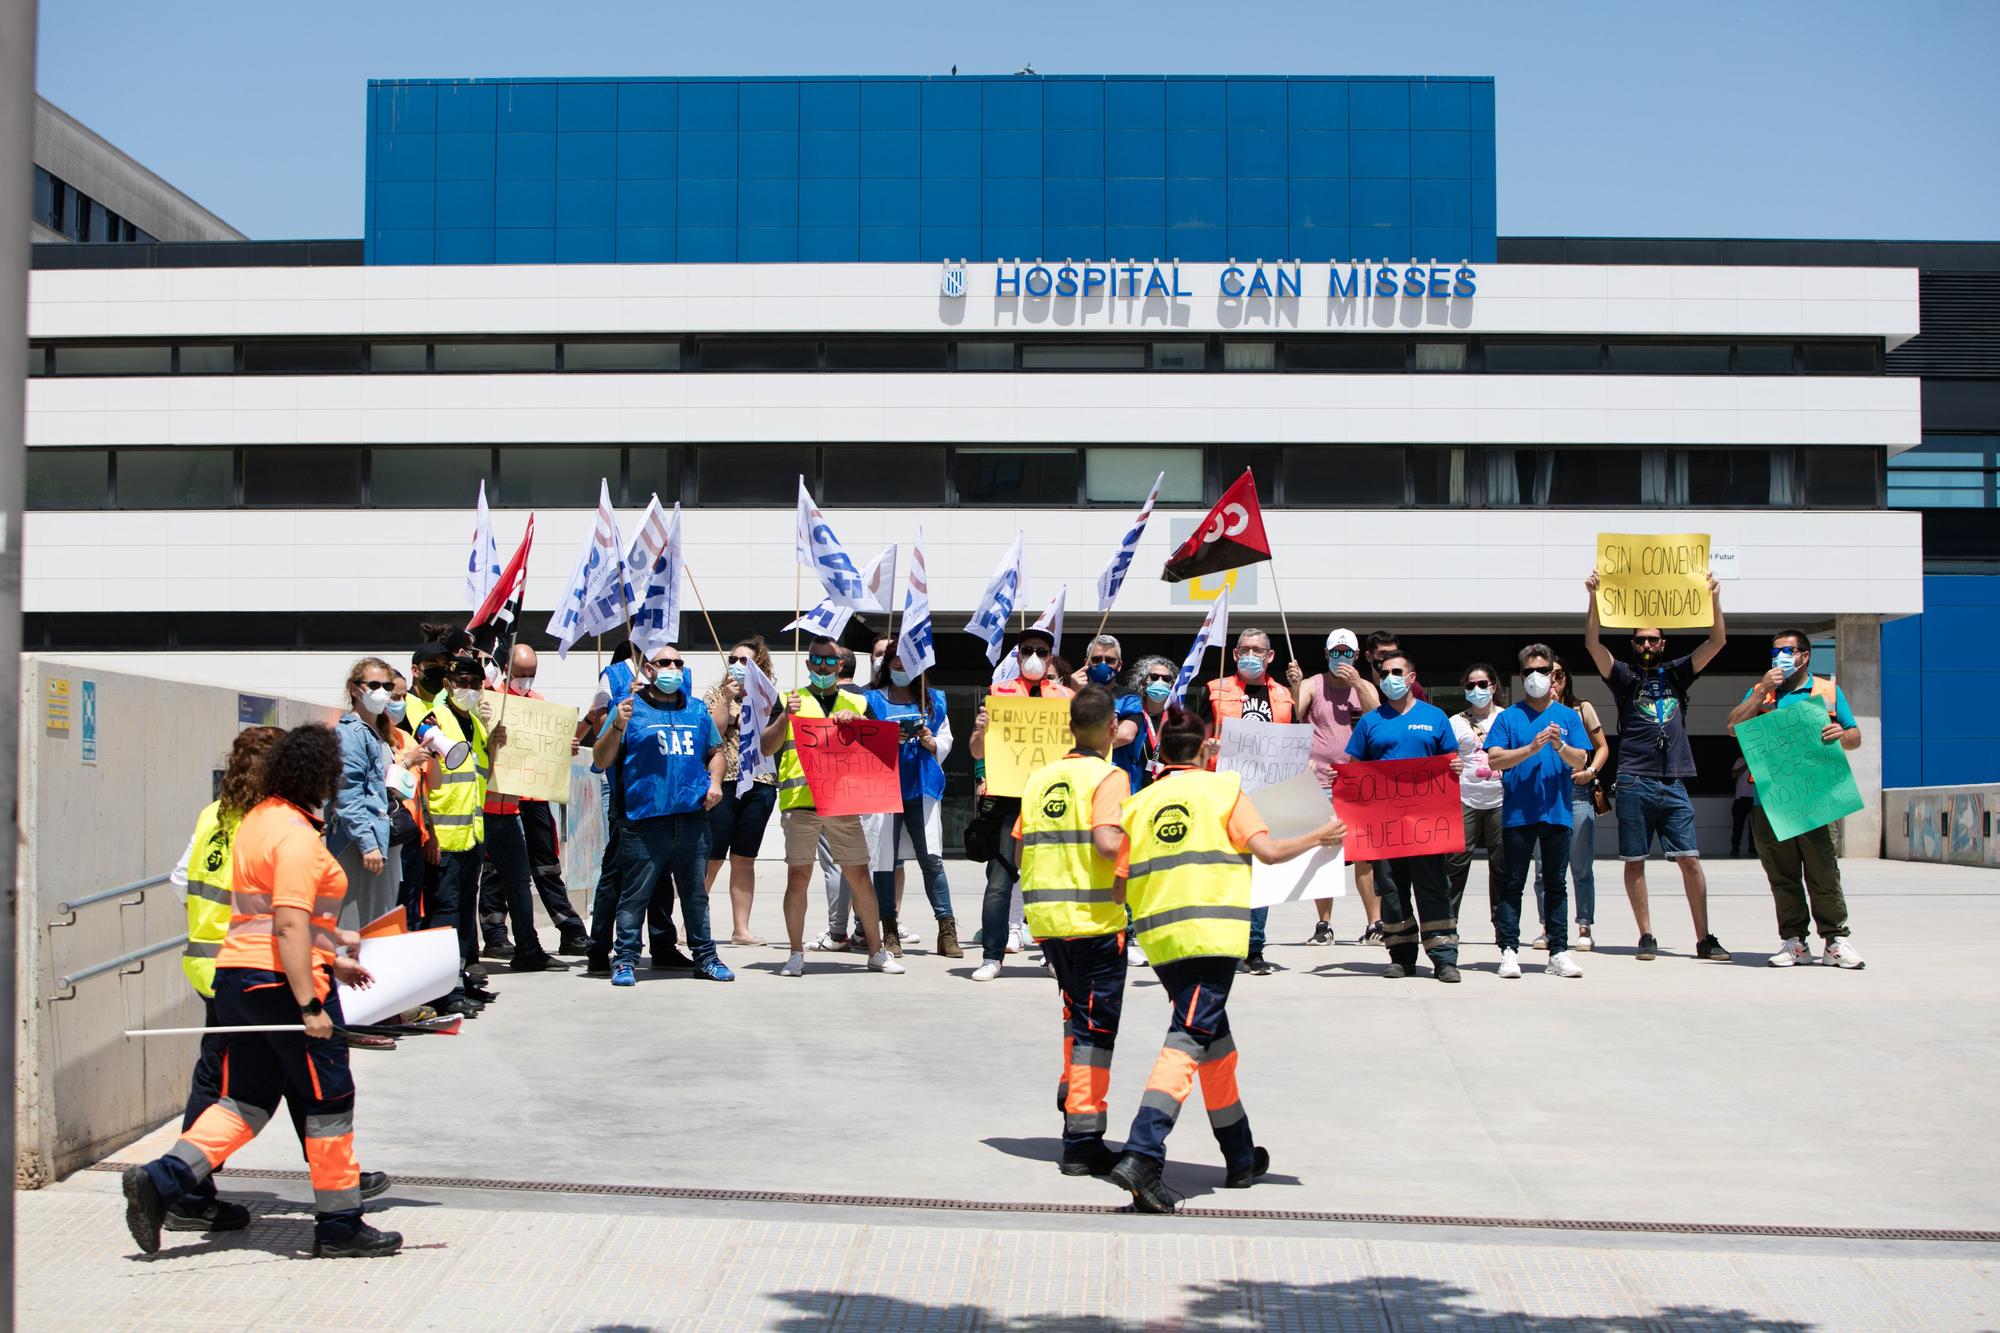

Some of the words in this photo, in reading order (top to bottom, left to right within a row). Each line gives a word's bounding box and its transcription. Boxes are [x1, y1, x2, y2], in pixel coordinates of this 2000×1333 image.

[996, 267, 1192, 297] HOSPITAL
[1220, 267, 1301, 297] CAN
[1330, 267, 1476, 297] MISSES
[992, 709, 1070, 726] CONVENI
[800, 723, 881, 748] STOP
[803, 750, 896, 773] ONTRATOS
[1010, 746, 1047, 766] YA
[1768, 785, 1792, 808] NO
[1793, 774, 1822, 796] ME
[1160, 826, 1185, 837] CGT
[1355, 816, 1450, 849] HUELGA
